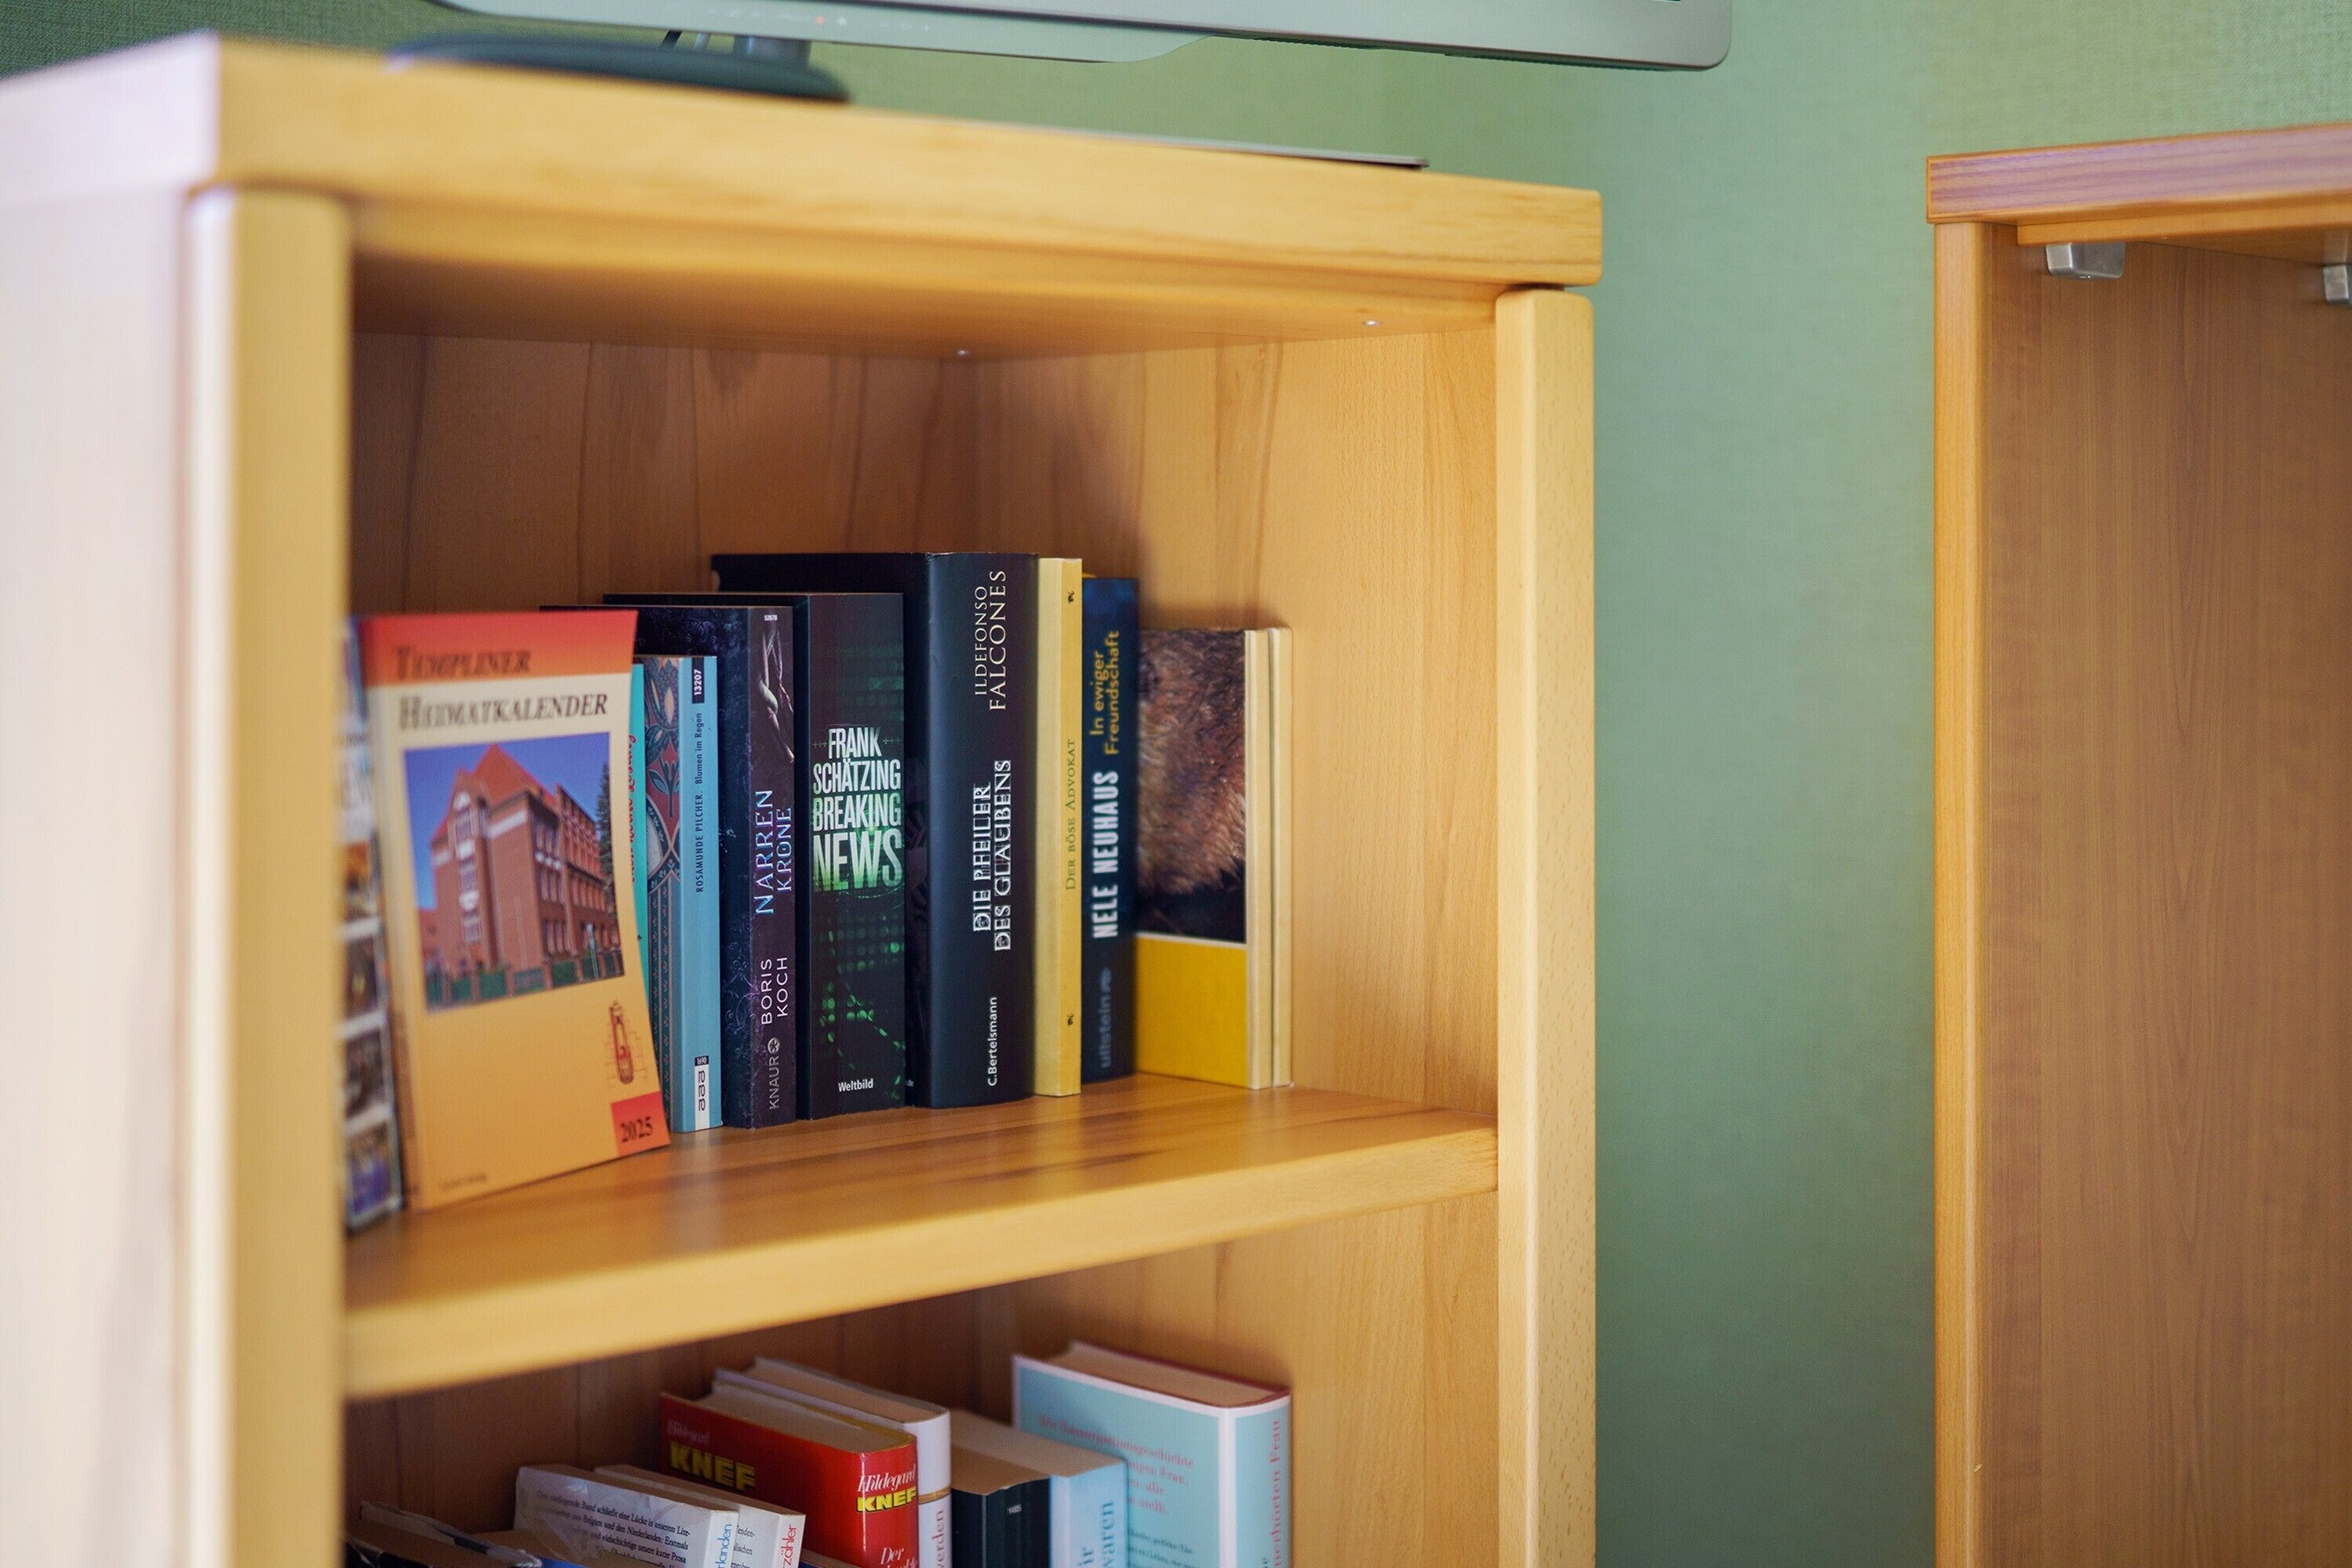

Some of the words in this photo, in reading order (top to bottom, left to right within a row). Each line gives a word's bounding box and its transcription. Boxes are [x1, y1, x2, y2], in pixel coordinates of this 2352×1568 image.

[975, 586, 988, 695] ILDEFONSO
[989, 571, 1007, 710] FALCONES
[693, 669, 702, 696] 13207
[1091, 651, 1109, 711] ewiger
[1104, 630, 1120, 755] Freundschaft
[400, 693, 608, 729] HEIMATKALENDER
[694, 713, 704, 740] Regen
[1090, 717, 1104, 735] In
[695, 740, 702, 750] im
[828, 727, 882, 759] FRANK
[695, 753, 703, 784] Blumen
[813, 759, 901, 795] SCHÄTZING
[695, 791, 704, 832] PILCHER.
[813, 793, 901, 832] BREAKING
[973, 782, 991, 881] PFEILER
[994, 760, 1011, 896] GLAUBENS
[1092, 771, 1119, 874] NEUHAUS
[695, 836, 704, 892] ROSAMUNDE
[755, 790, 774, 913] NARREN
[776, 808, 792, 891] KRONE
[813, 829, 902, 892] NEWS
[973, 890, 991, 931] DIE
[994, 905, 1011, 951] DES
[1092, 885, 1118, 938] NELE
[760, 959, 772, 1025] BORIS
[776, 957, 788, 1017] KOCH
[988, 997, 997, 1086] C.Bertelsmann
[769, 1055, 779, 1109] KNAUR
[838, 1079, 873, 1092] Weltbild
[620, 1116, 653, 1142] 2025
[1269, 1420, 1280, 1464] Frau
[670, 1442, 757, 1491] KNEF
[857, 1464, 916, 1493] Hildegard
[630, 1513, 648, 1526] Lücke
[856, 1486, 916, 1513] KNEF
[880, 1547, 905, 1564] Der
